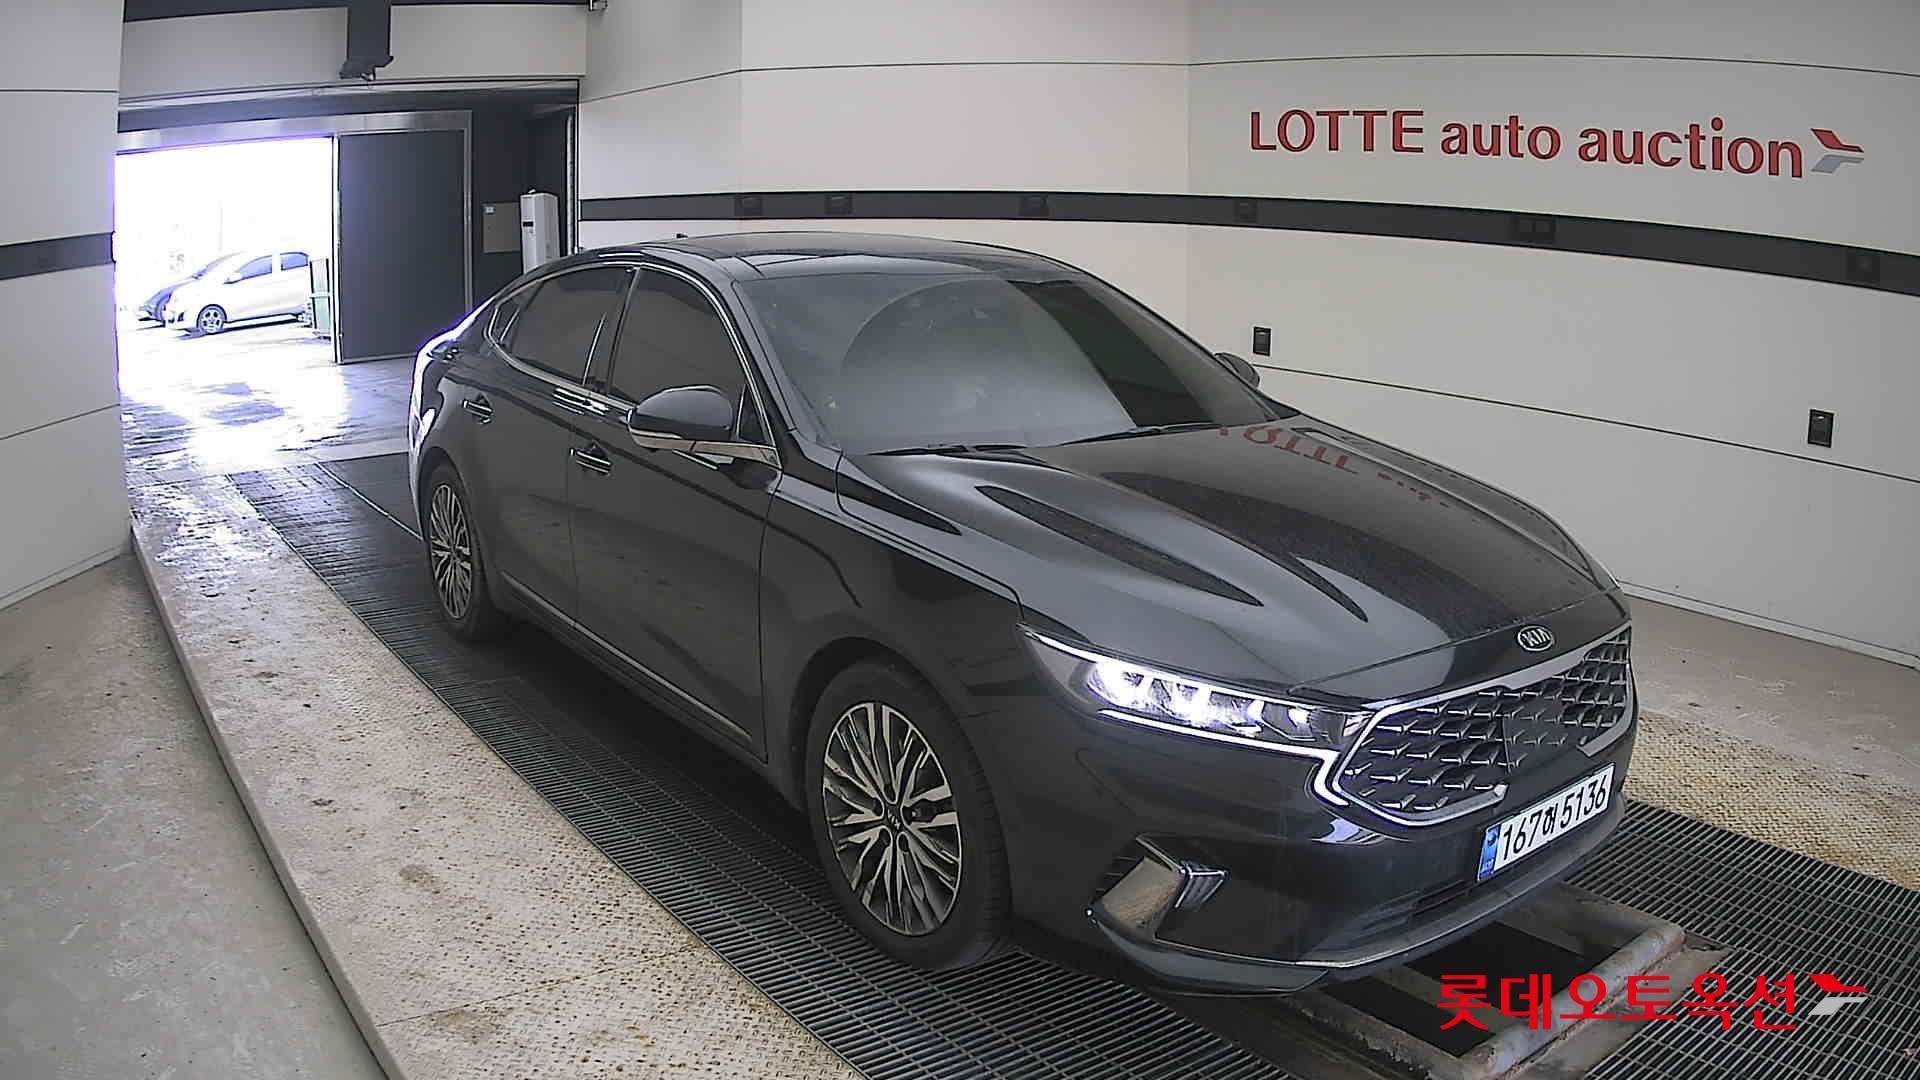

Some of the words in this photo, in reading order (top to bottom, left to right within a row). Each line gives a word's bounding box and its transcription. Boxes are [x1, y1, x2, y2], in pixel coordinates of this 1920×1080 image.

[1250, 111, 1424, 153] LOTTE
[1441, 115, 1561, 159] auto
[1578, 117, 1803, 178] auction
[1521, 628, 1551, 647] KIA
